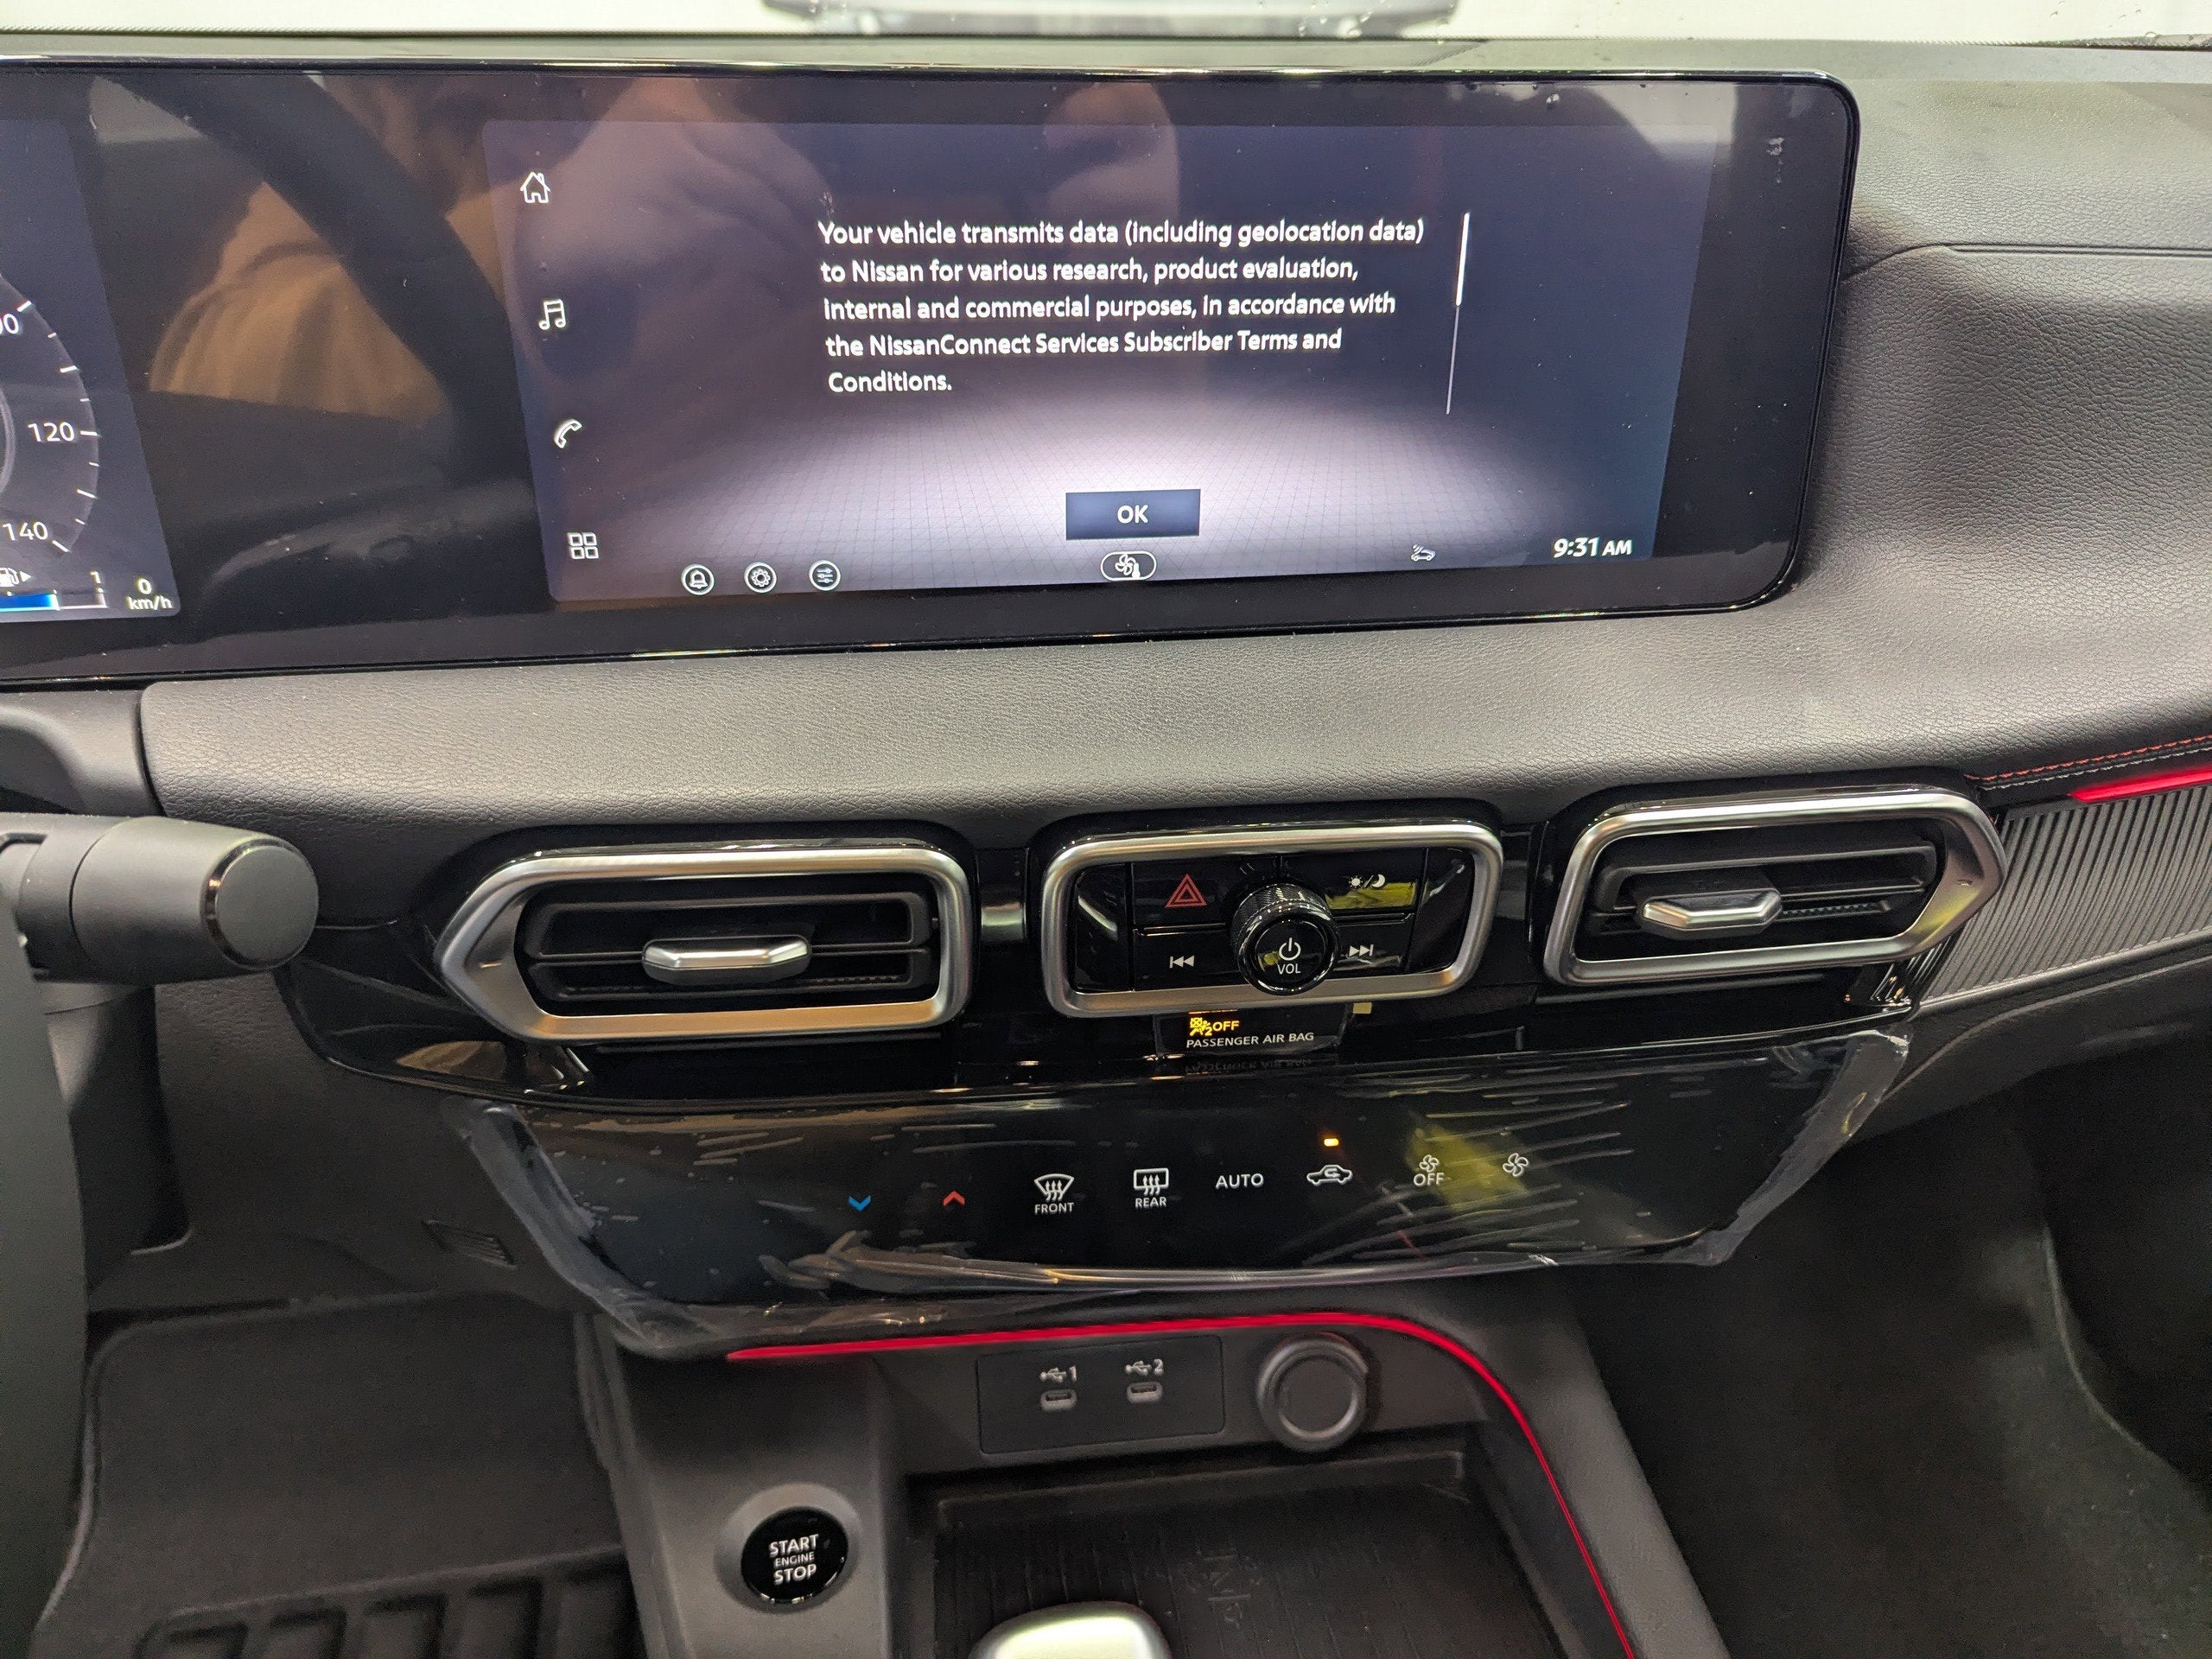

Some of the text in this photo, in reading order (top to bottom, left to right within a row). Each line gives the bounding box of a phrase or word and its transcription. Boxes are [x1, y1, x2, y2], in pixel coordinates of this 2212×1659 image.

[817, 219, 1424, 248] Your vehicle transmits data (including geolocation data)
[820, 256, 1358, 284] to Nissan for various research, product evaluation,
[823, 290, 1396, 322] internal and commercial purposes, in accordance with
[825, 327, 1343, 357] the NissanConnect Services Subscriber Terms and
[828, 371, 952, 392] Conditions.
[28, 421, 75, 442] 120
[1117, 504, 1148, 524] OK
[3, 521, 49, 542] 140
[1553, 537, 1633, 558] 9:31 AM
[90, 570, 103, 584] 1
[137, 577, 153, 595] 0
[125, 594, 174, 612] km/h
[1277, 963, 1301, 975] VOL
[1212, 1020, 1240, 1033] OFF
[1185, 1032, 1314, 1049] PASSENGER AIR BAG
[1214, 1173, 1265, 1190] AUTO
[1413, 1172, 1445, 1188] OFF
[1033, 1201, 1075, 1215] FRONT
[1135, 1196, 1167, 1210] REAR
[1068, 1365, 1077, 1382] 1
[1153, 1358, 1165, 1376] 2
[768, 1533, 820, 1559] START
[773, 1551, 815, 1569] ENGINE
[772, 1563, 817, 1586] STOP
